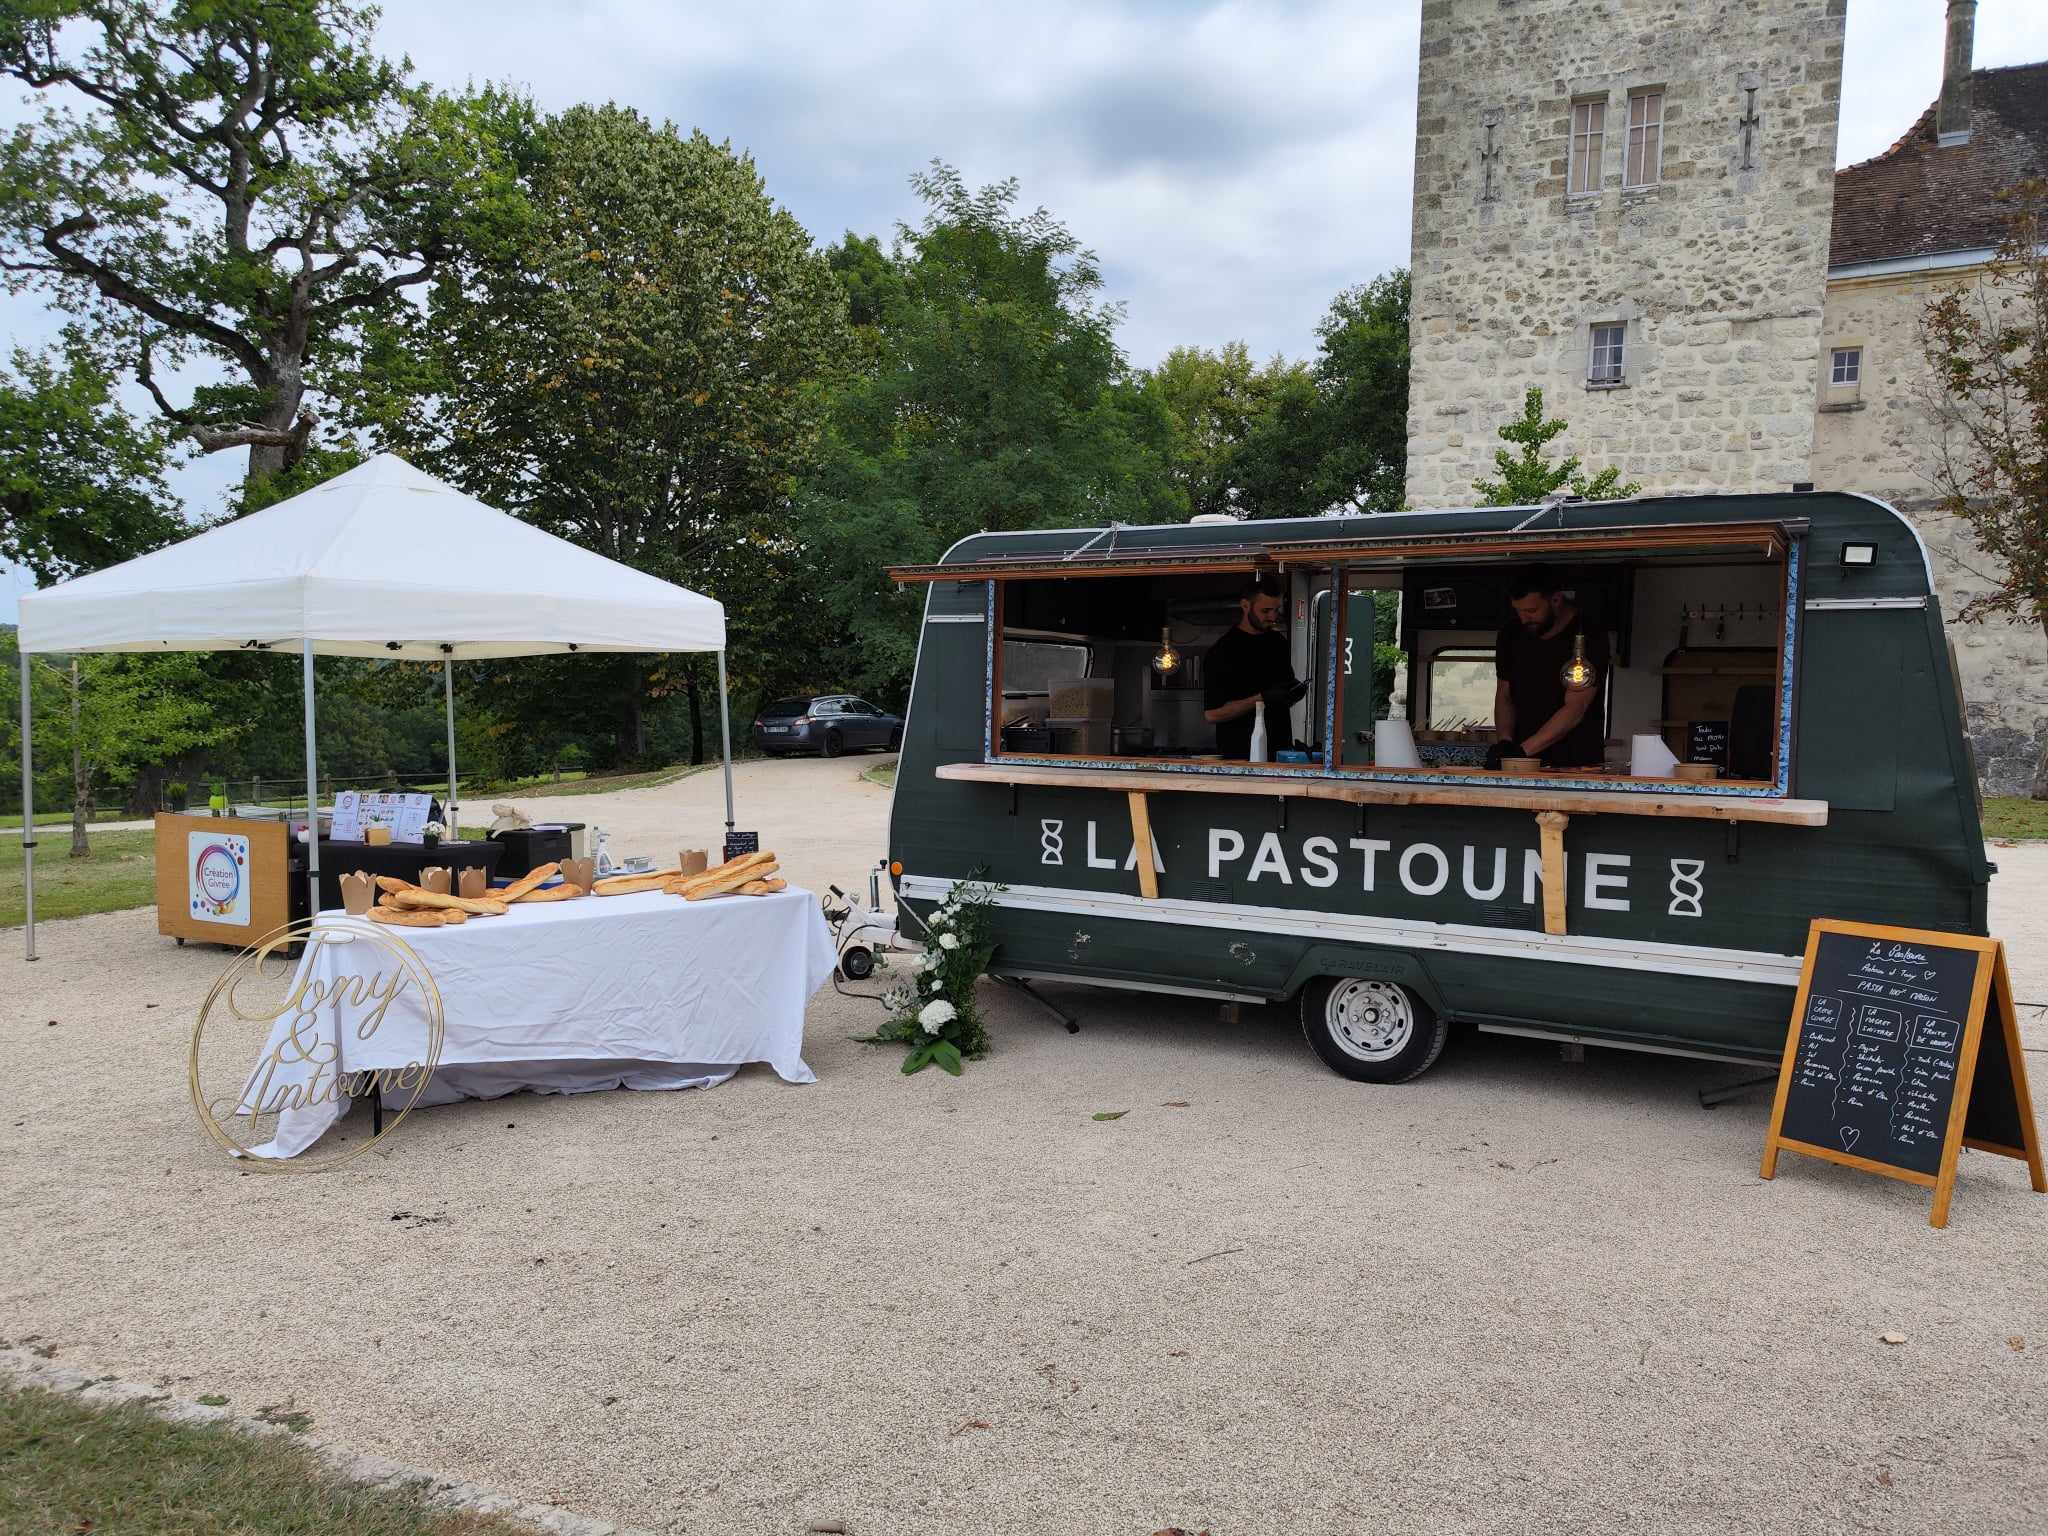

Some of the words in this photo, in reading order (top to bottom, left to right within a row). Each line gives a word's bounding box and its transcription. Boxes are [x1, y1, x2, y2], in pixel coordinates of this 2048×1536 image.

[204, 867, 234, 879] Création
[1209, 828, 1631, 911] PASTOUNE
[227, 931, 413, 1040] Tony
[1857, 981, 1884, 993] PASTA
[1909, 992, 1938, 1003] MAISON
[278, 1011, 339, 1064] &
[208, 1053, 423, 1130] Antoine
